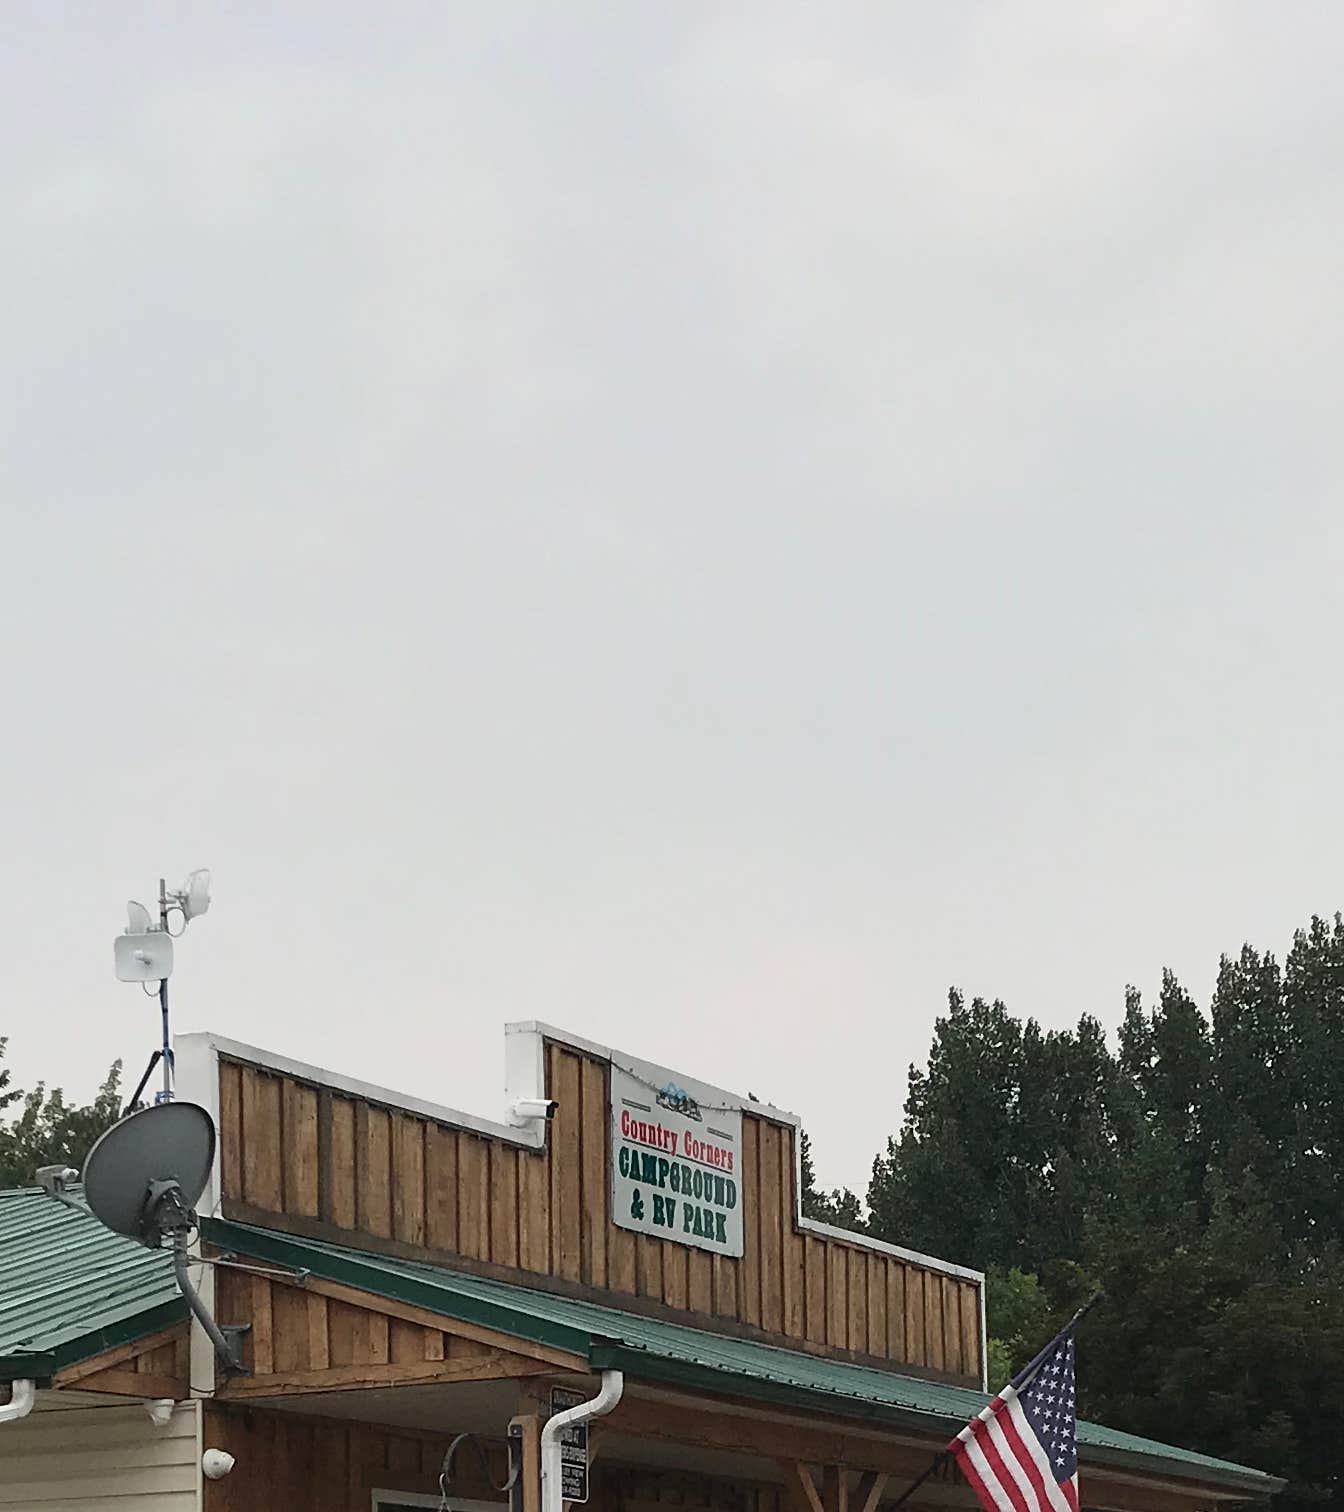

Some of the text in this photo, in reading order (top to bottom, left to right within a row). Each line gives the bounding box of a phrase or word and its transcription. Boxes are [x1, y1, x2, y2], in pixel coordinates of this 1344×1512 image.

[620, 1109, 734, 1170] Country Corners
[619, 1146, 737, 1209] CAMPGROUND
[630, 1188, 727, 1244] & RV PARK
